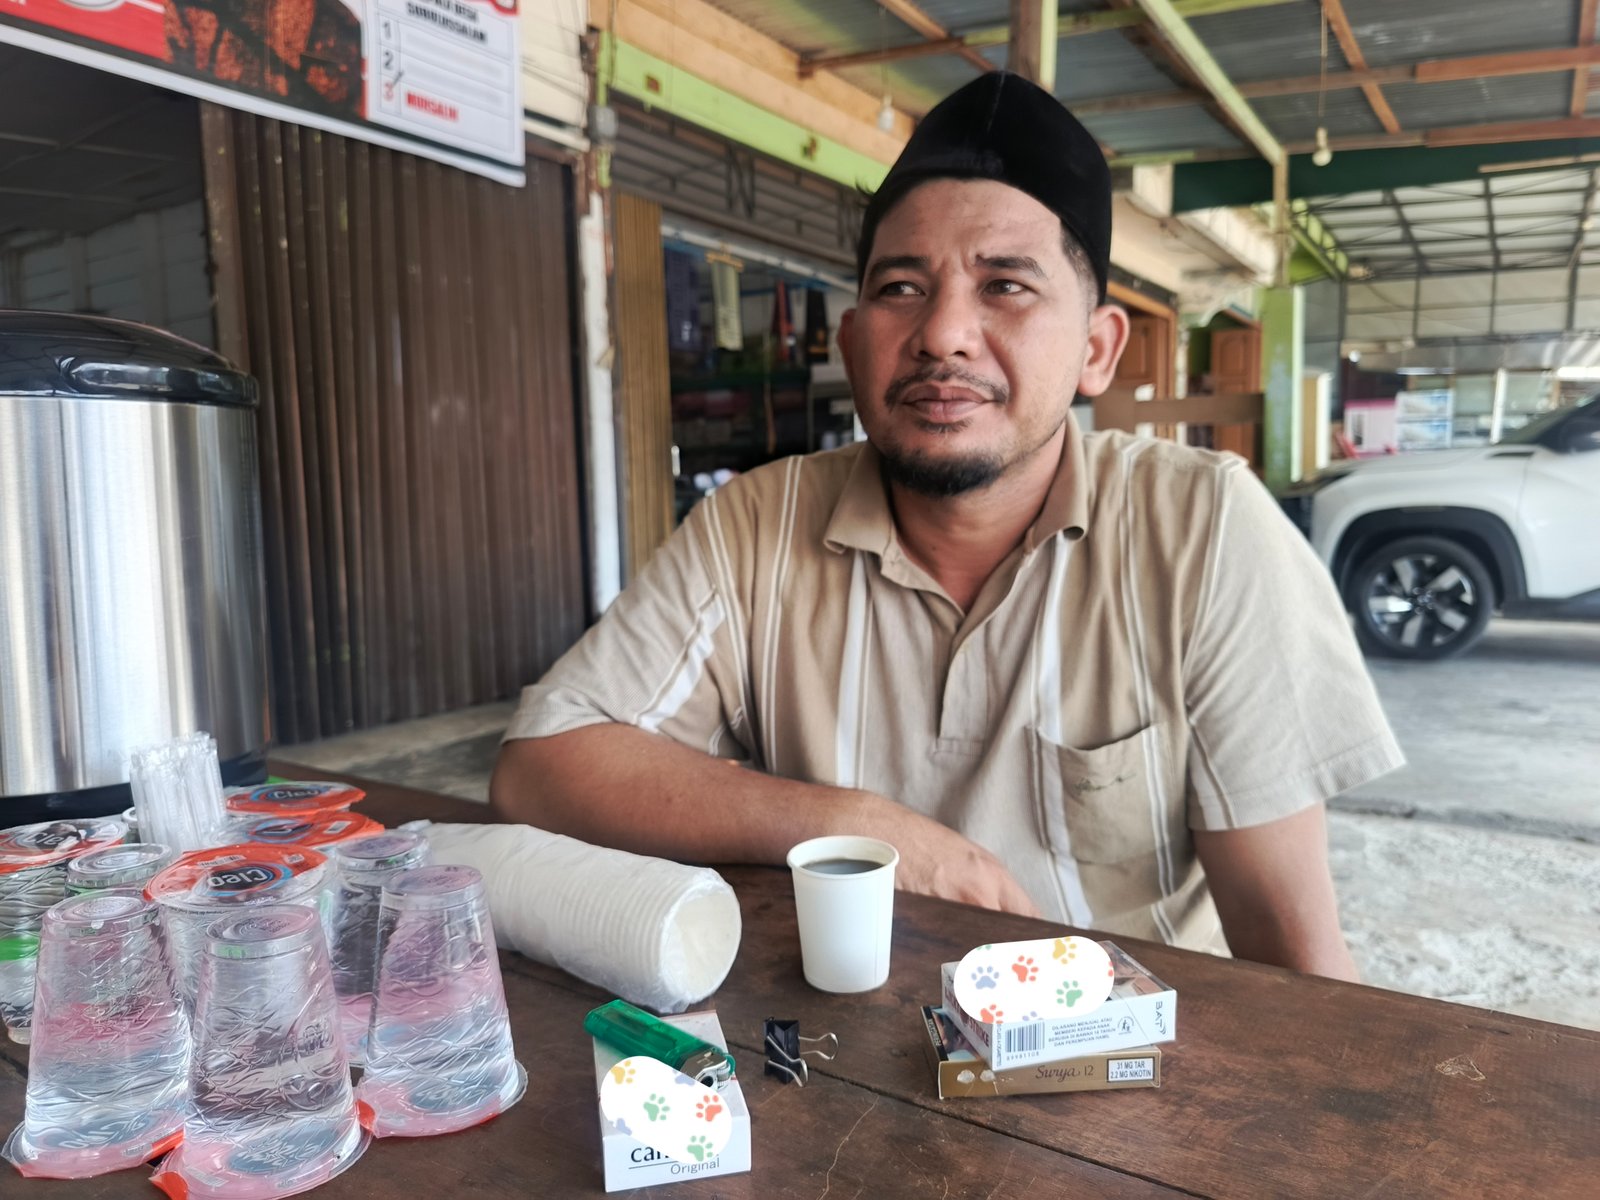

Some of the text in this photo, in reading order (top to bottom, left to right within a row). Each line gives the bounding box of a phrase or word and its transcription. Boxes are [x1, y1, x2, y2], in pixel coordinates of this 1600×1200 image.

[384, 22, 392, 40] 1
[385, 51, 393, 70] 2
[384, 81, 394, 101] 3
[207, 868, 268, 888] Cleo
[1155, 1001, 1163, 1028] BAT
[1035, 1065, 1094, 1082] Surya 12
[1110, 1069, 1152, 1079] 2.2 MG NIKOTIN
[1117, 1061, 1123, 1069] 31
[670, 1154, 720, 1175] Original
